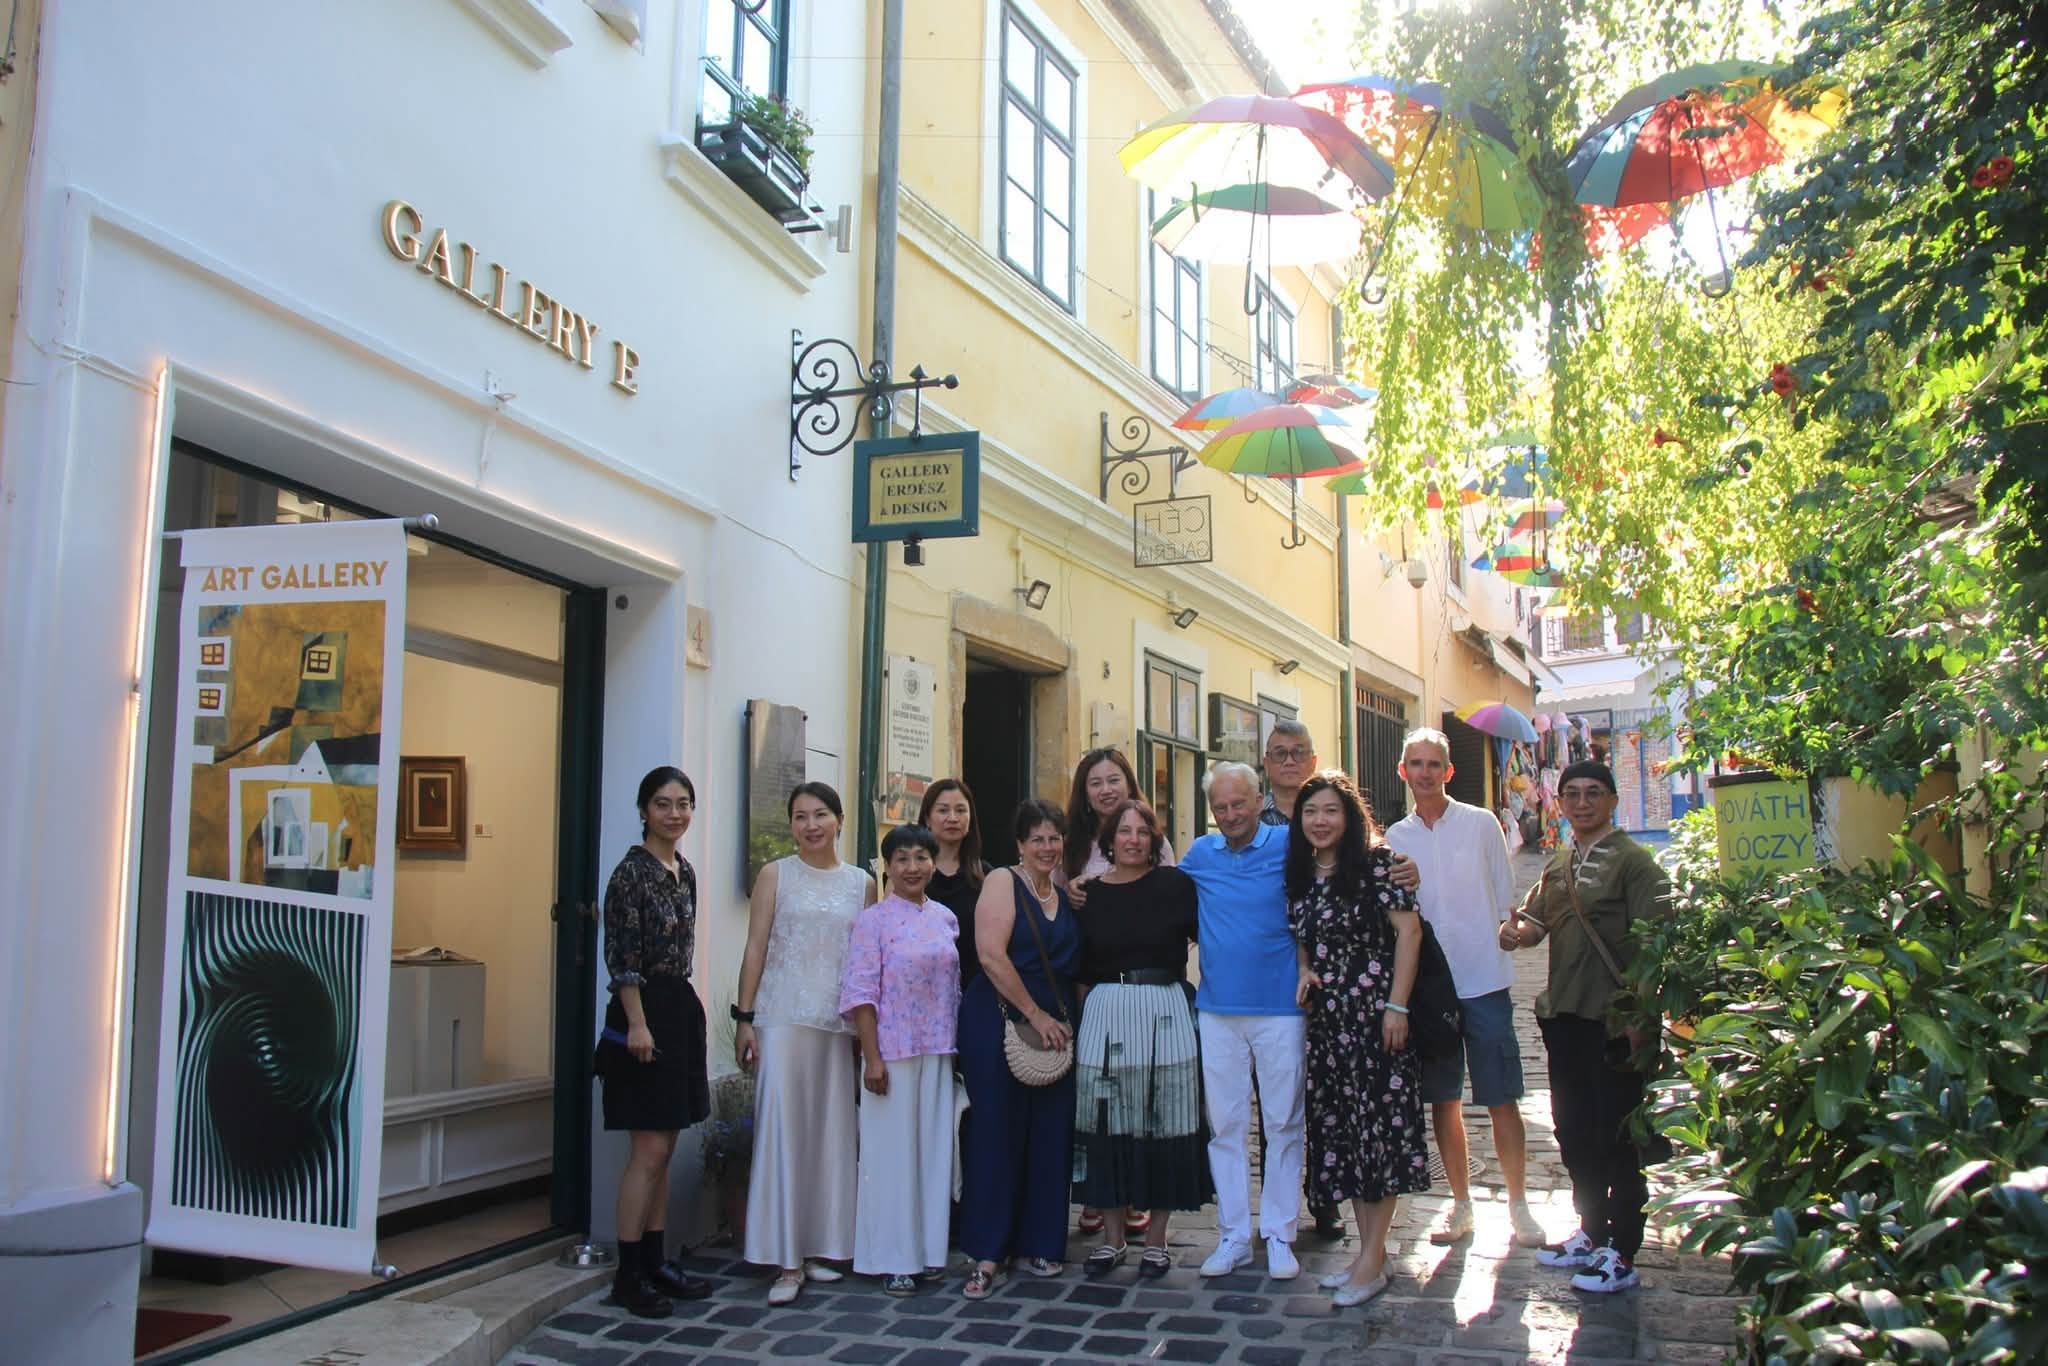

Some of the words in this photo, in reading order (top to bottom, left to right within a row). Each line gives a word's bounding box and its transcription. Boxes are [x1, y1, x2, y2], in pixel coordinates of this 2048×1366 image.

[381, 200, 600, 369] GALLERY
[611, 340, 640, 395] E
[880, 463, 952, 480] GALLERY
[887, 480, 946, 497] ERDÉSZ
[892, 501, 948, 515] DESIGN
[202, 567, 255, 592] ART
[261, 561, 388, 590] GALLERY
[1727, 832, 1808, 861] LÓCZY
